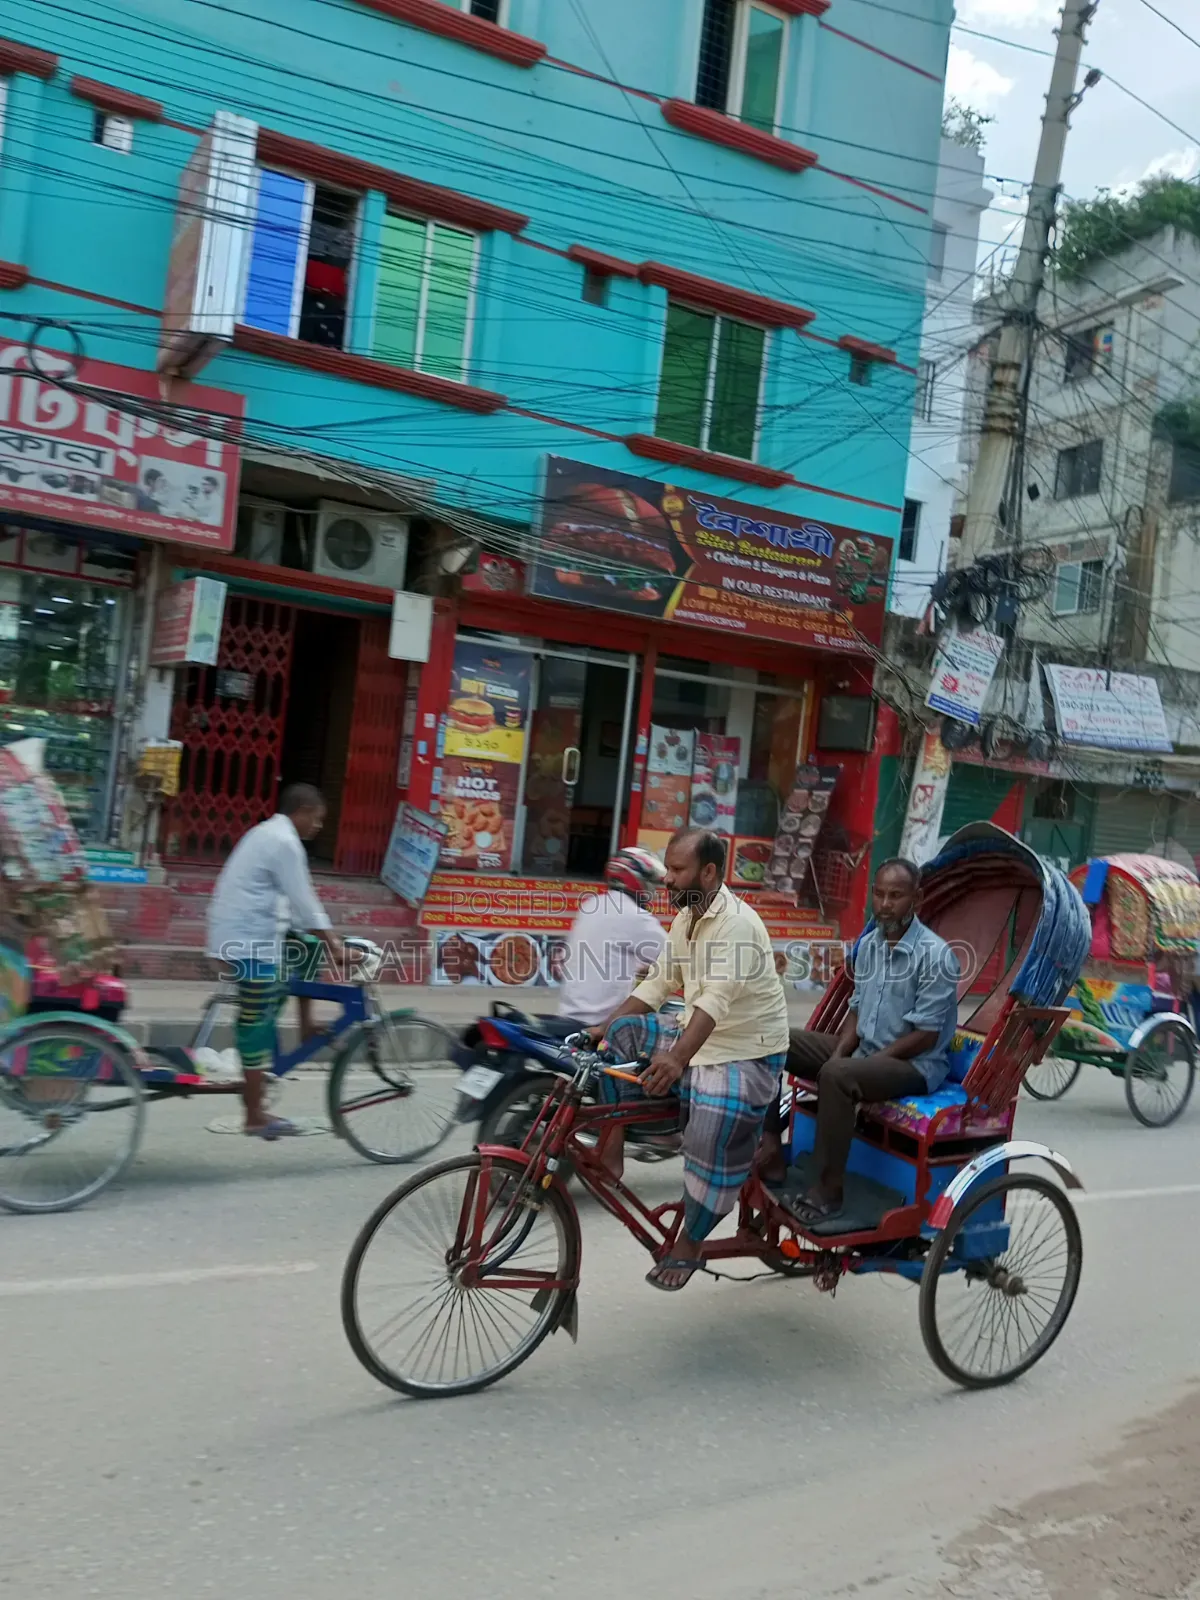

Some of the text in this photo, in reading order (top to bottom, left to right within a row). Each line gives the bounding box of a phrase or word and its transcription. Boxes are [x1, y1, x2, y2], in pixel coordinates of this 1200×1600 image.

[722, 576, 833, 610] IN OUR RESTAURANT
[458, 776, 498, 791] HOT
[453, 786, 500, 801] WINGS
[474, 877, 500, 888] Fried
[502, 878, 527, 890] Rice
